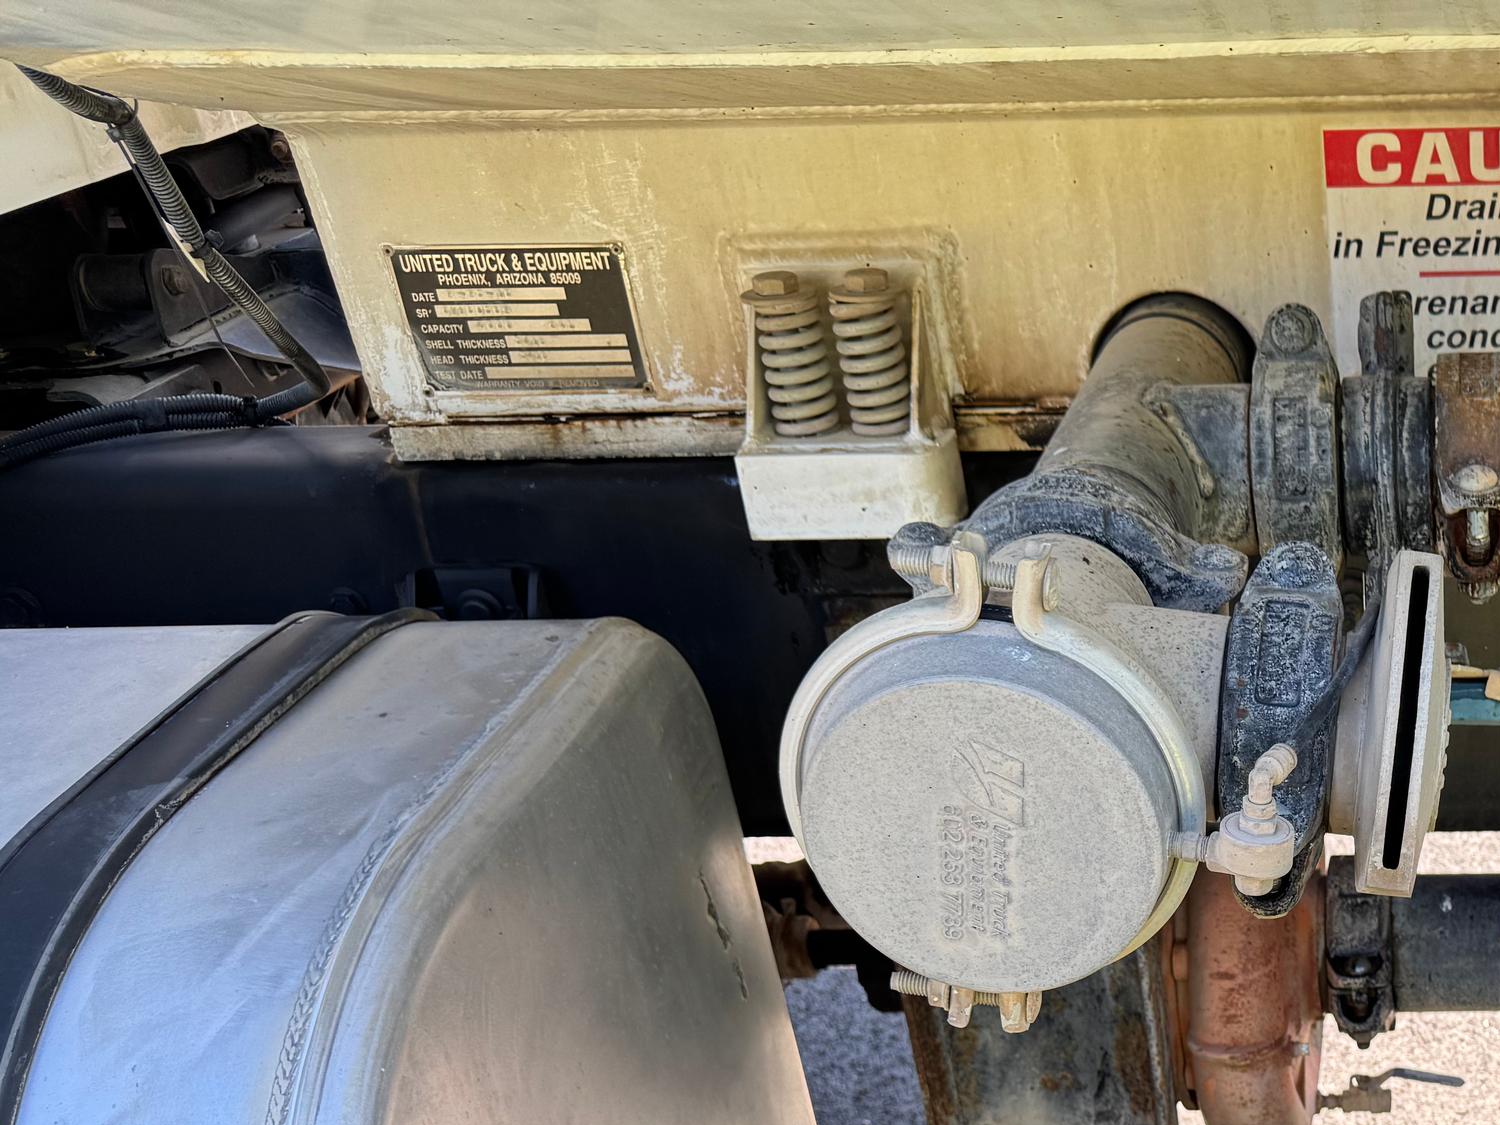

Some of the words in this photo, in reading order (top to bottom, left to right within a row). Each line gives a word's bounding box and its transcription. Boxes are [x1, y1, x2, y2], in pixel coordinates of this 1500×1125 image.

[1332, 231, 1363, 259] in
[398, 253, 455, 273] UNITED
[454, 252, 510, 272] TRUCK
[511, 252, 523, 272] &
[523, 251, 611, 271] EQUIPMENT
[437, 273, 492, 288] PHOENIX,
[496, 272, 546, 286] ARIZONA
[549, 272, 582, 285] 85009
[411, 292, 437, 303] DATE
[420, 323, 464, 335] CAPACITY
[425, 339, 455, 350] SHELL
[456, 338, 507, 350] THICKNESS
[430, 355, 455, 365] HEAD
[458, 354, 510, 365] THICKNESS
[434, 370, 457, 380] TEST
[459, 370, 485, 380] DATE
[991, 823, 1013, 888] United
[942, 850, 965, 887] 253
[968, 834, 989, 934] Equipment
[991, 889, 1013, 939] Truck
